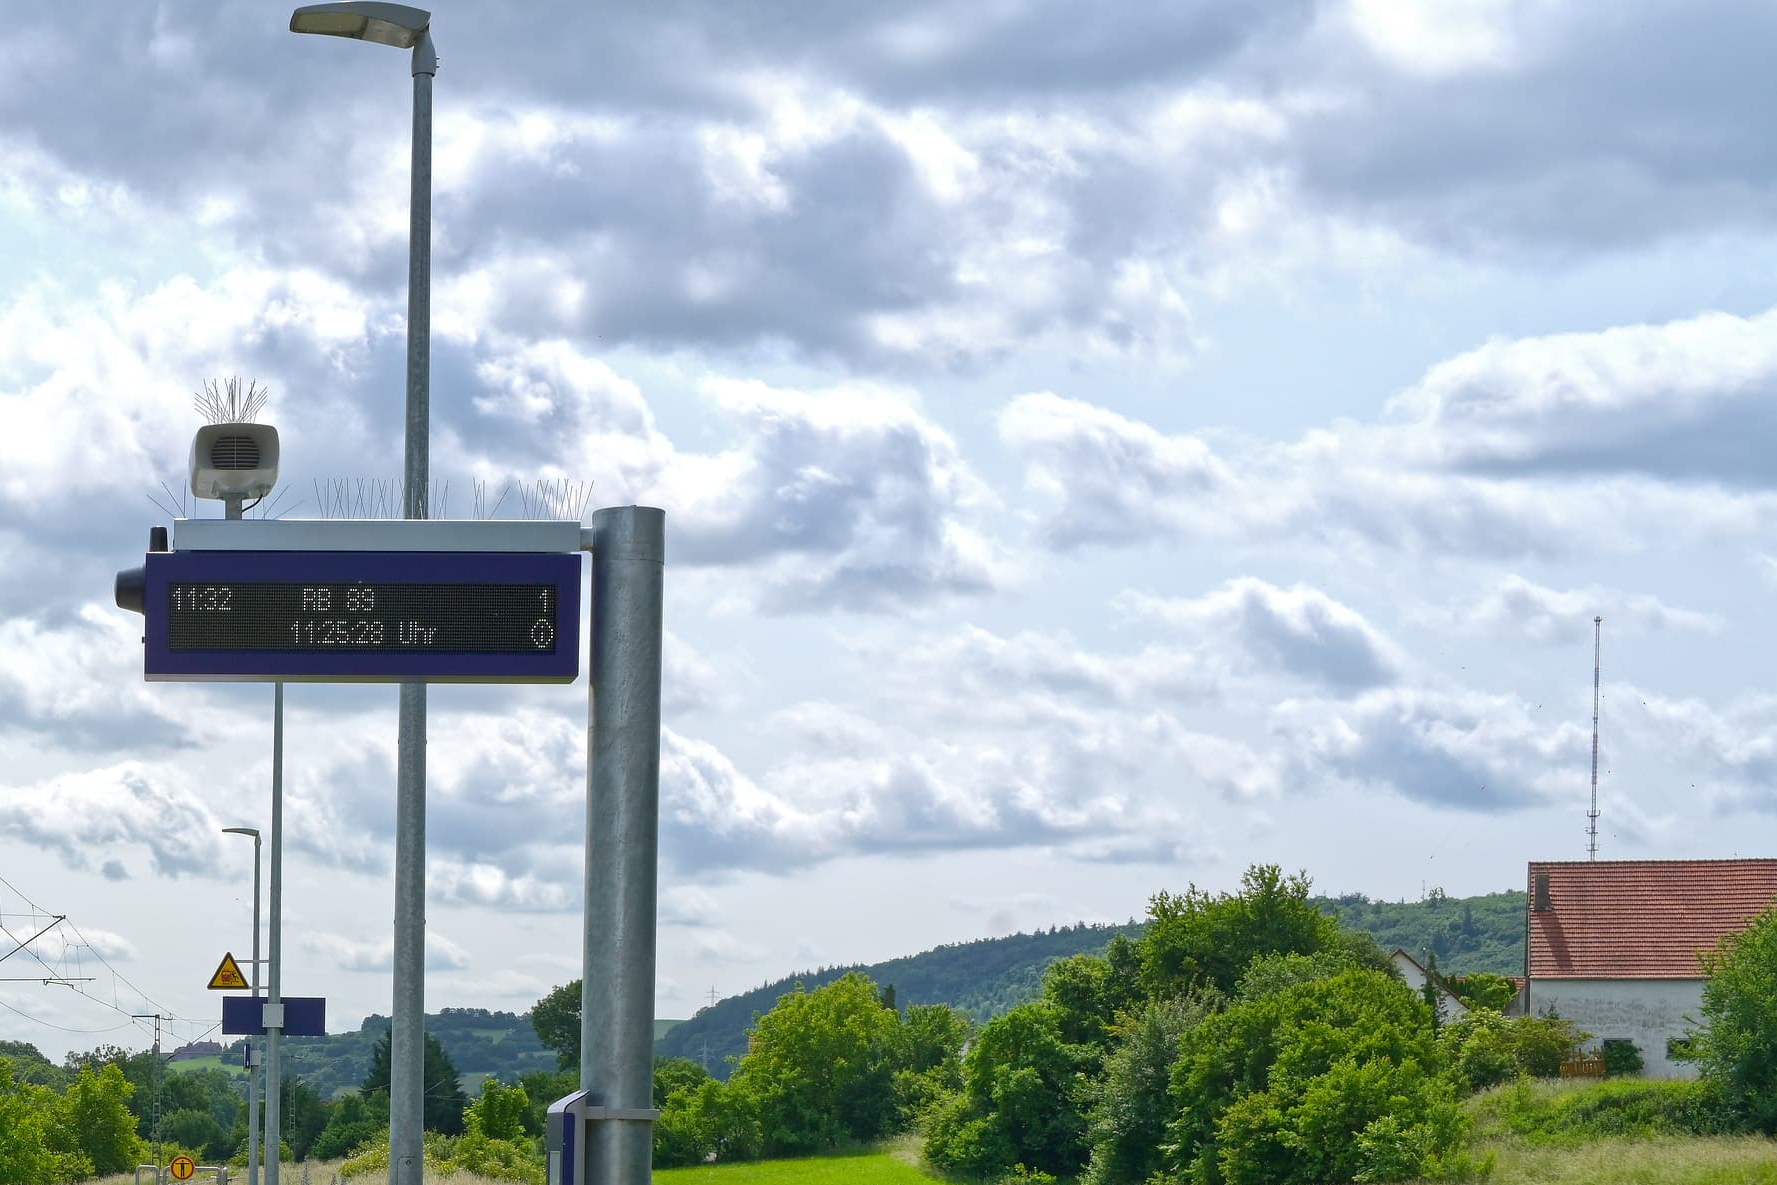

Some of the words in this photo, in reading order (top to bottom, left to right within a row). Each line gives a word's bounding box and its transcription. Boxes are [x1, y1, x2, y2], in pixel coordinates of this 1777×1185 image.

[172, 587, 232, 611] 11:32
[303, 588, 331, 611] RB
[347, 588, 375, 611] 89
[539, 590, 547, 612] 1
[290, 620, 384, 644] 11:25:28
[399, 621, 437, 644] Uhr
